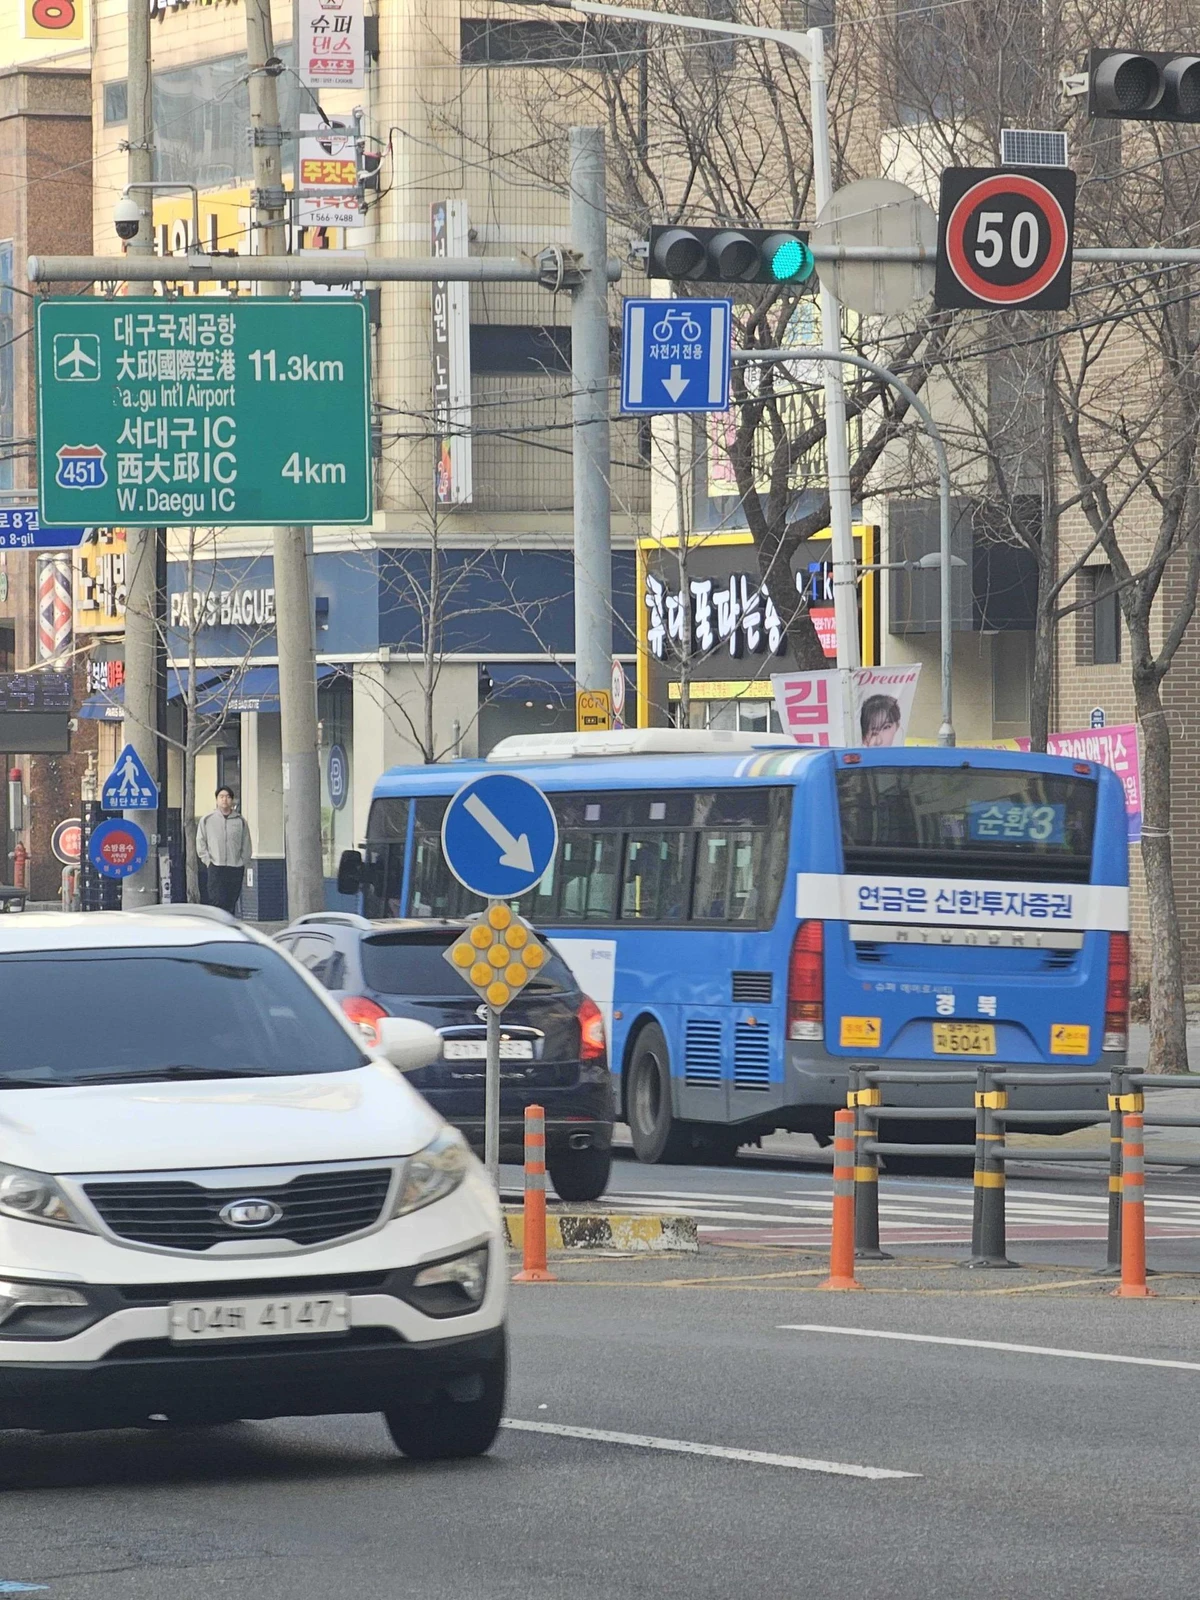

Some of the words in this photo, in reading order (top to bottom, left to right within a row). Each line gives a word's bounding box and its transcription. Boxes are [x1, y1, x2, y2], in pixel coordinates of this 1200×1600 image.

[310, 15, 353, 34] 슈퍼
[312, 36, 352, 55] 댄스
[311, 60, 352, 74] 스포츠
[304, 161, 357, 184] 주짓수
[974, 211, 1039, 268] 50
[114, 312, 236, 347] 대구국제공항
[649, 343, 680, 360] 자전거
[682, 343, 703, 360] 전용
[116, 347, 236, 381] 大邱國際空港
[247, 349, 344, 381] 11.3km
[113, 386, 156, 413] agu
[160, 382, 183, 408] Int'l
[186, 383, 236, 412] Airport
[63, 461, 95, 483] 451
[281, 451, 346, 484] 4km
[211, 487, 236, 512] IC
[9, 532, 35, 547] 8-gil
[170, 590, 217, 627] PARIS
[853, 669, 917, 687] Dream
[581, 697, 605, 709] CCTV
[103, 843, 135, 853] 소방용수
[858, 885, 927, 913] 연금은
[934, 889, 1073, 919] 신한투자증권
[258, 1300, 336, 1332] 4147
